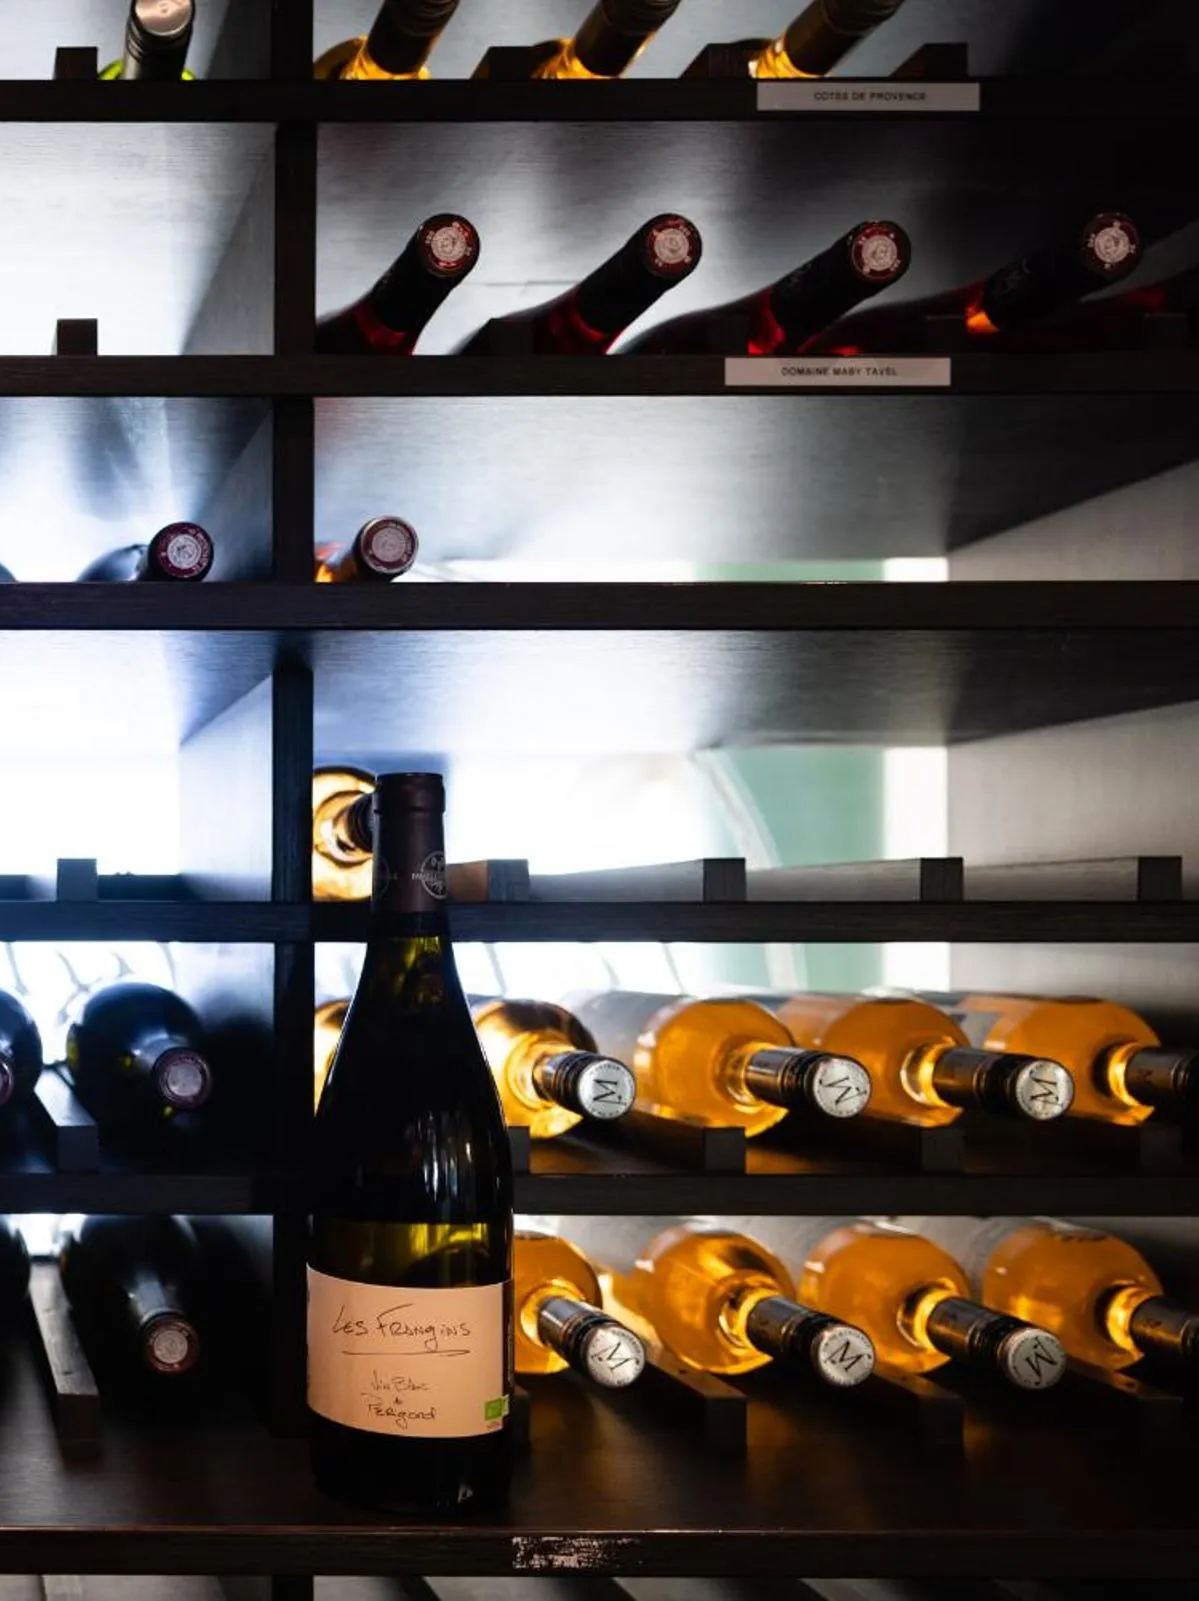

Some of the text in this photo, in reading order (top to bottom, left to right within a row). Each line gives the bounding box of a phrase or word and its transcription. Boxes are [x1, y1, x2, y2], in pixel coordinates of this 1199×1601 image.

[851, 91, 866, 101] DE
[869, 91, 927, 101] PROVENCE
[781, 367, 830, 377] DOMAINE
[865, 367, 898, 377] TAVEL
